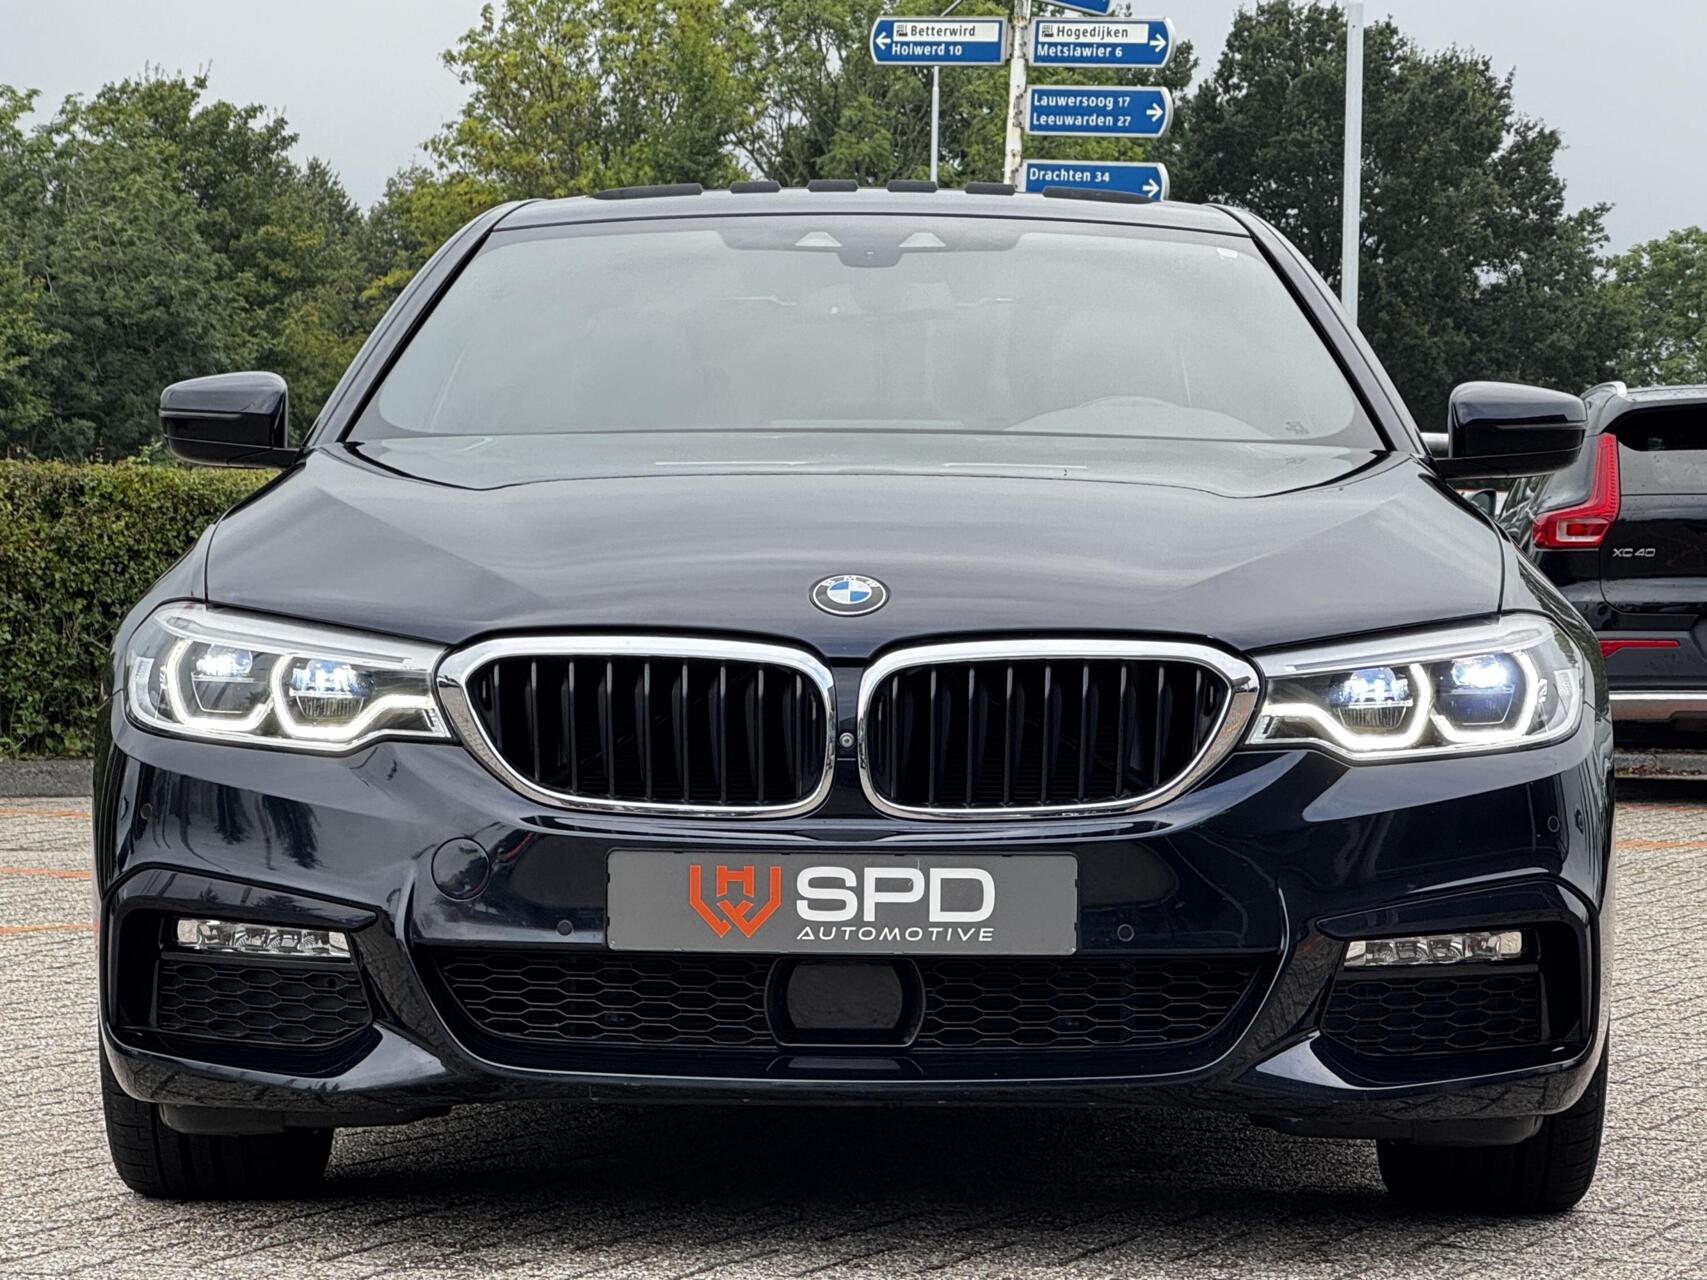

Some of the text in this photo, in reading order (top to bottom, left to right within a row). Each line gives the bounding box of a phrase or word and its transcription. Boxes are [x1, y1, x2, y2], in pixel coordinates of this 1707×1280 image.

[910, 25, 976, 37] Betterwird
[1056, 26, 1129, 40] Hogedijken
[891, 43, 963, 56] Holwerd 10
[1036, 43, 1123, 57] Metslawier 6
[1033, 94, 1131, 109] Lauwersoog 17
[1032, 112, 1132, 127] Leeuwarden 27
[1029, 168, 1111, 183] Drachten 34
[796, 866, 996, 923] SPD
[796, 926, 994, 941] AUTOMOTIVE
